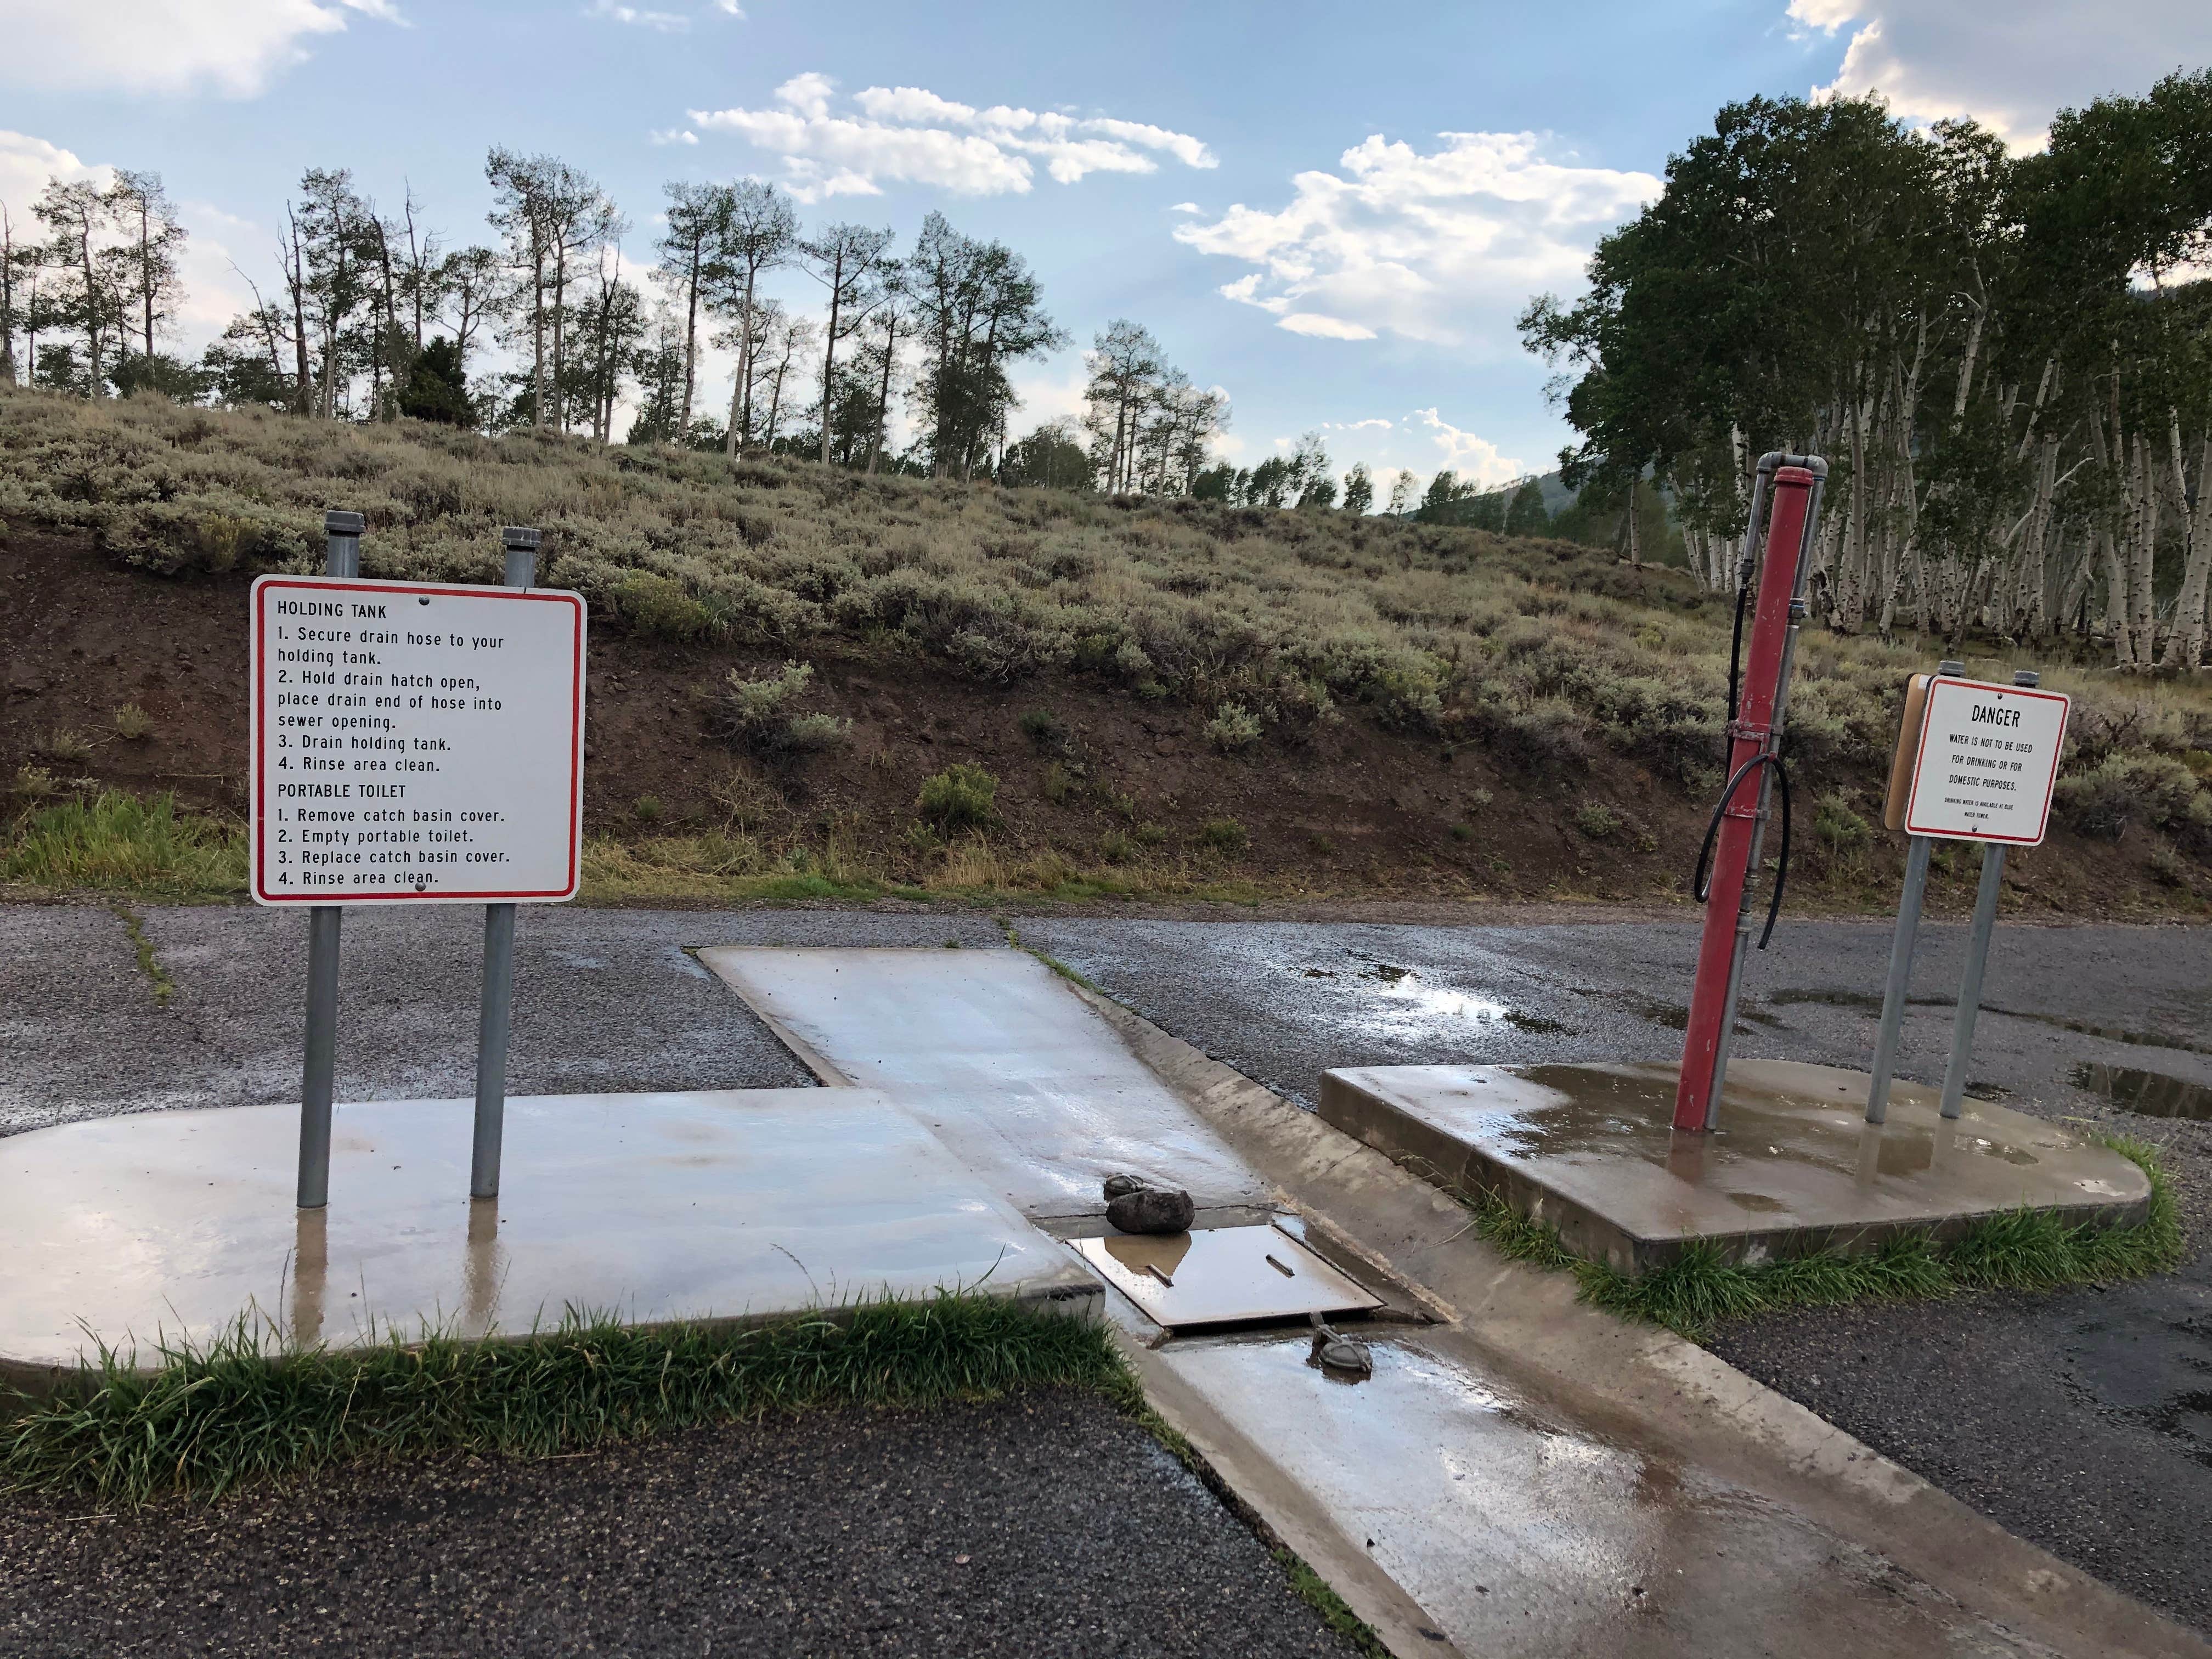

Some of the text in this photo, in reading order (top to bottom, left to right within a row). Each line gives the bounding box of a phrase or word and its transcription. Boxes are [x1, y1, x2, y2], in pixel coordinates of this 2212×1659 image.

[278, 600, 386, 619] HOLDING TANK
[278, 625, 504, 651] 1. Secure drain hose to your
[278, 648, 381, 668] holding tank.
[278, 669, 479, 692] 2. Hold drain hatch open,
[278, 691, 501, 710] place drain end of hose into
[278, 715, 396, 733] sewer opening.
[1971, 704, 2021, 728] DANGER
[278, 734, 451, 754] 3. Drain holding tank.
[1949, 733, 2033, 753] WATER IS NOT TO BE USED
[278, 756, 439, 771] 4. Rinse area clean.
[1951, 754, 2022, 772] FOR DRINKING OR FOR
[278, 783, 406, 798] PORTABLE TOILET
[1949, 774, 2017, 791] DOMESTIC PURPOSES.
[278, 808, 505, 822] 1. Remove catch basin cover.
[278, 829, 473, 846] 2. Empty portable toilet.
[278, 849, 510, 867] 3. Replace catch basin cover.
[278, 871, 438, 885] 4. Rinse area clean.
